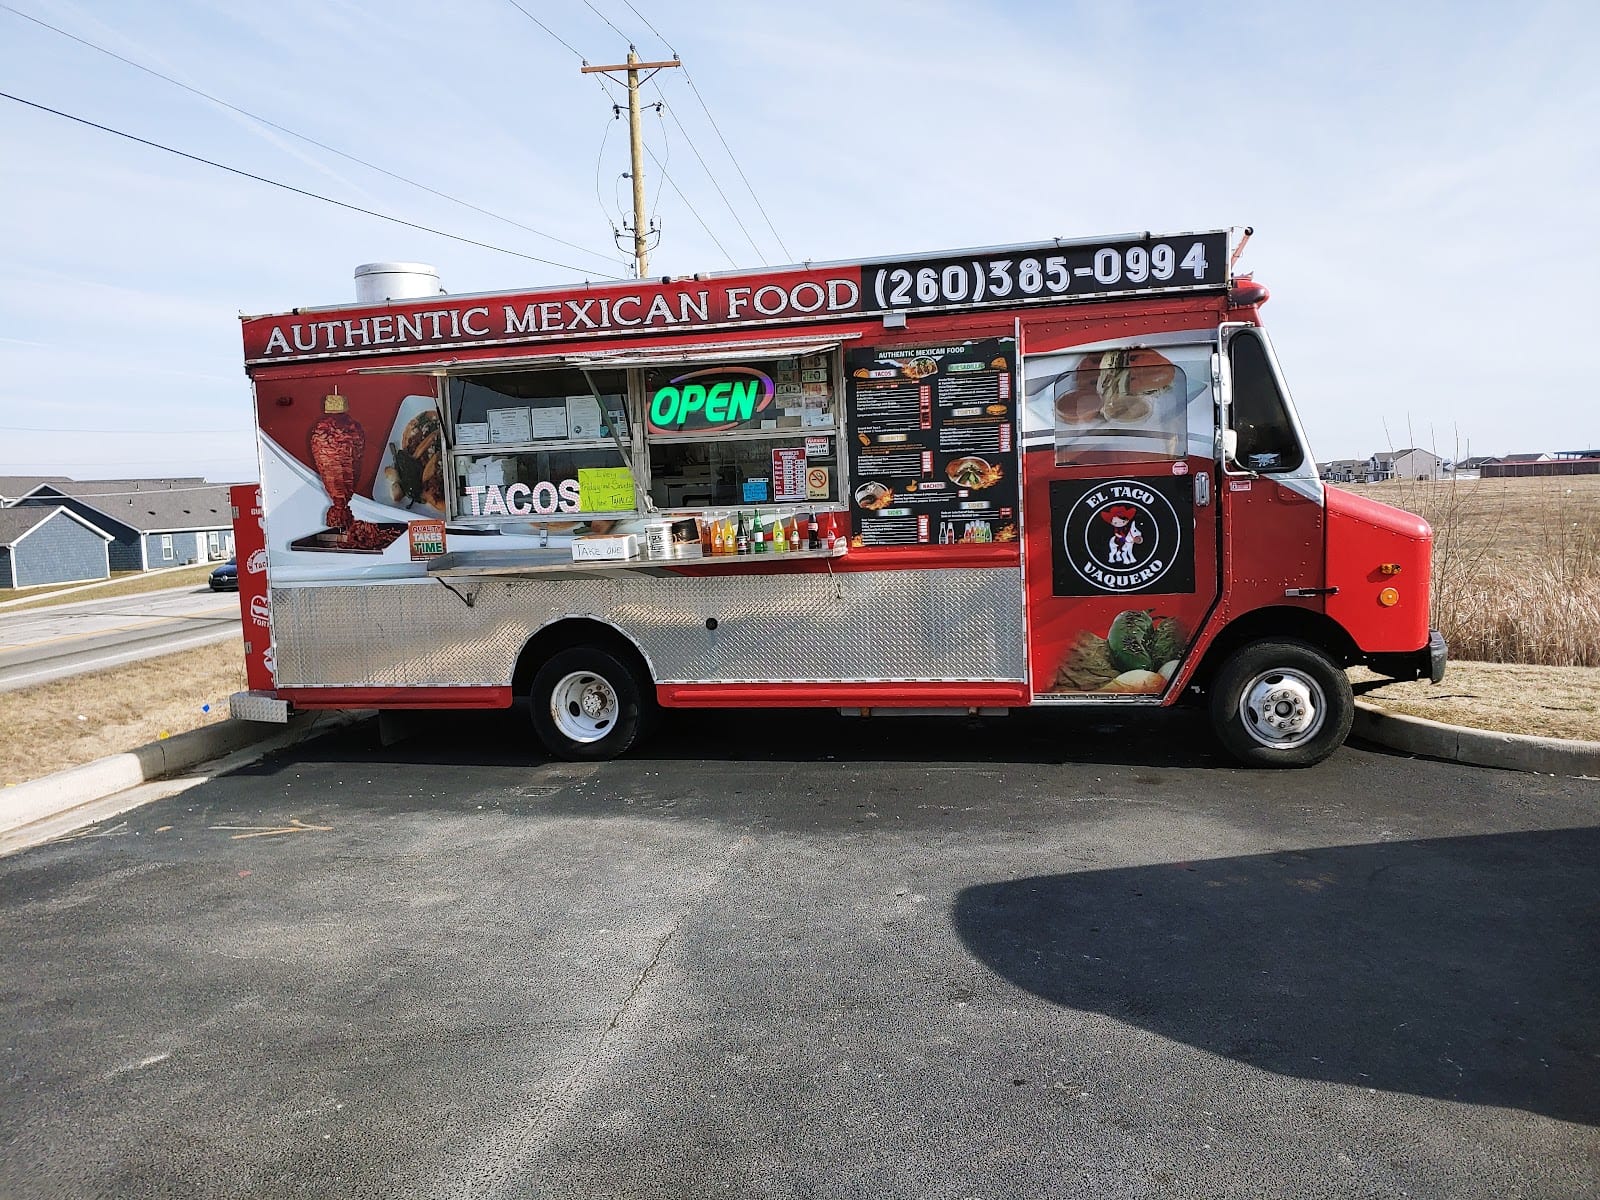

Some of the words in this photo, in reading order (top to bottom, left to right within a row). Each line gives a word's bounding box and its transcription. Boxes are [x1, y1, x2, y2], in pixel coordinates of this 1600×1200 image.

[873, 242, 1209, 306] (260)385-0994
[263, 307, 490, 355] AUTHENTIC
[503, 290, 709, 334] MEXICAN
[726, 278, 860, 319] FOOD
[879, 350, 915, 359] AUTHENTIC
[916, 348, 945, 356] MEXICAN
[946, 346, 964, 354] FOOD
[651, 380, 759, 426] OPEN
[465, 478, 580, 516] TACOS
[1085, 491, 1108, 510] EL
[1110, 486, 1155, 505] TACO
[412, 525, 441, 533] QUALITY
[413, 532, 443, 541] TAKES
[413, 542, 443, 554] TIME
[575, 544, 601, 557] TAKE
[606, 545, 623, 555] ONE
[1084, 559, 1164, 587] VAQUERO
